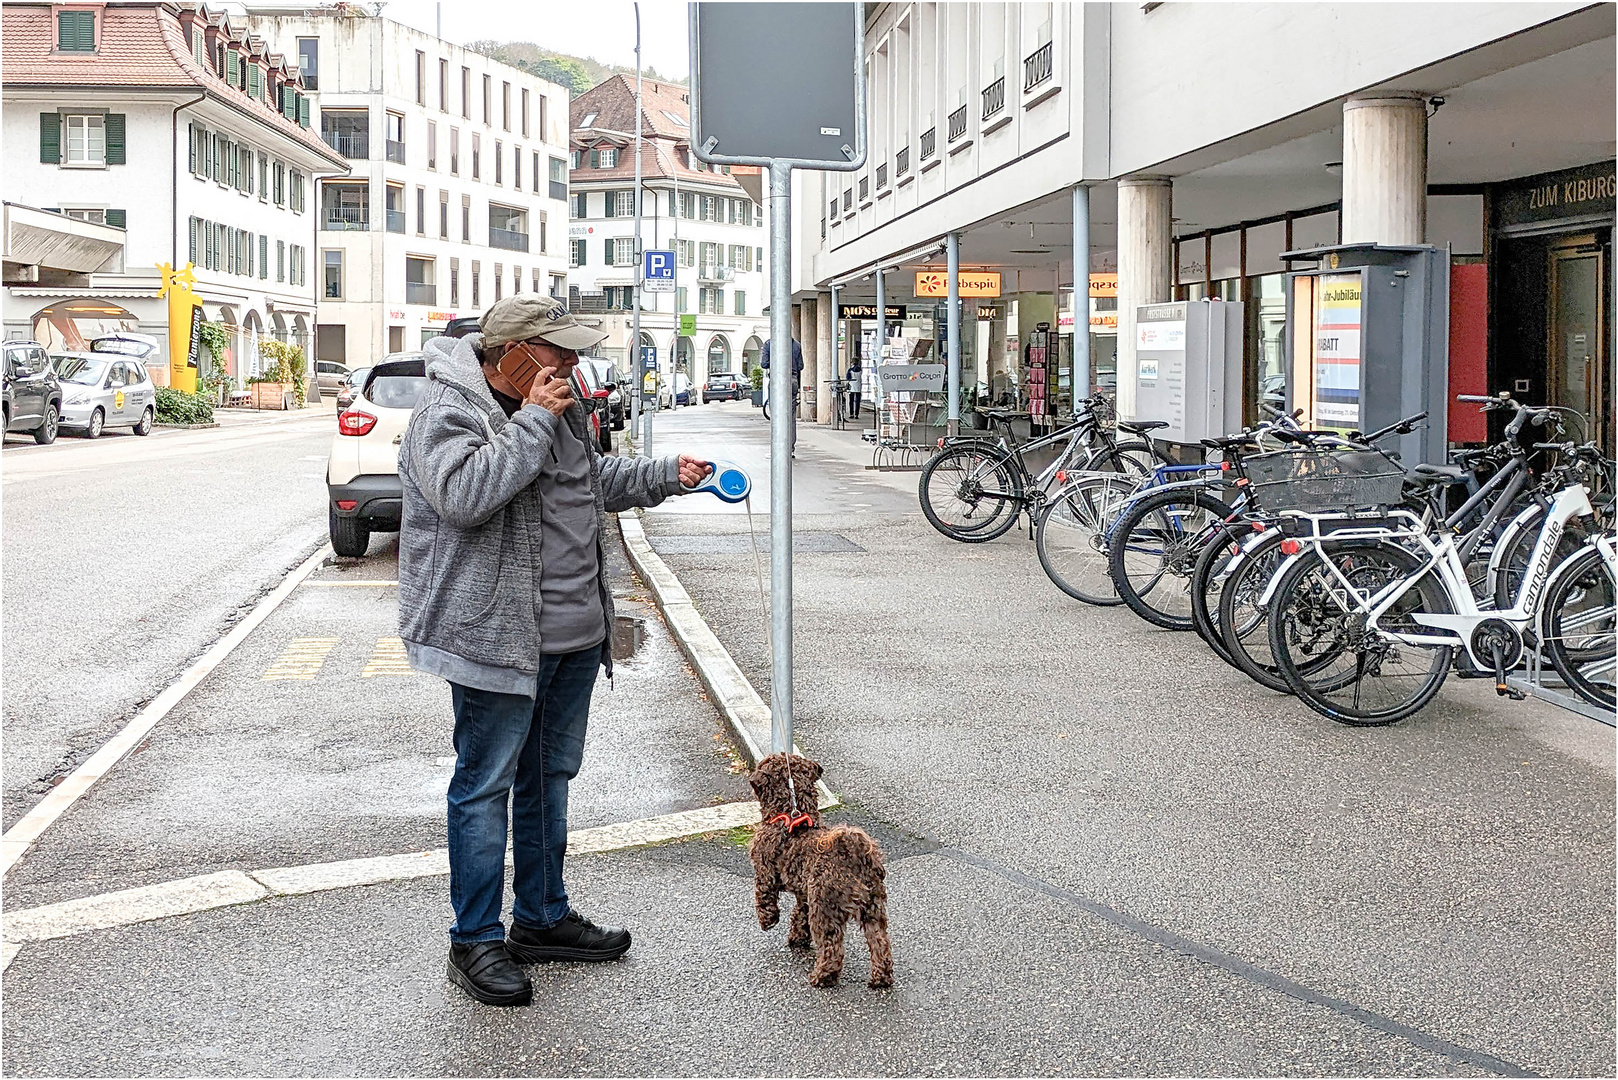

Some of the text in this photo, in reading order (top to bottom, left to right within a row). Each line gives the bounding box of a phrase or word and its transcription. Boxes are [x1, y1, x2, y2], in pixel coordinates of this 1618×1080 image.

[1529, 184, 1558, 209] ZUM
[650, 254, 666, 276] P
[188, 308, 201, 366] Flanierzone
[1523, 520, 1561, 616] cannondale
